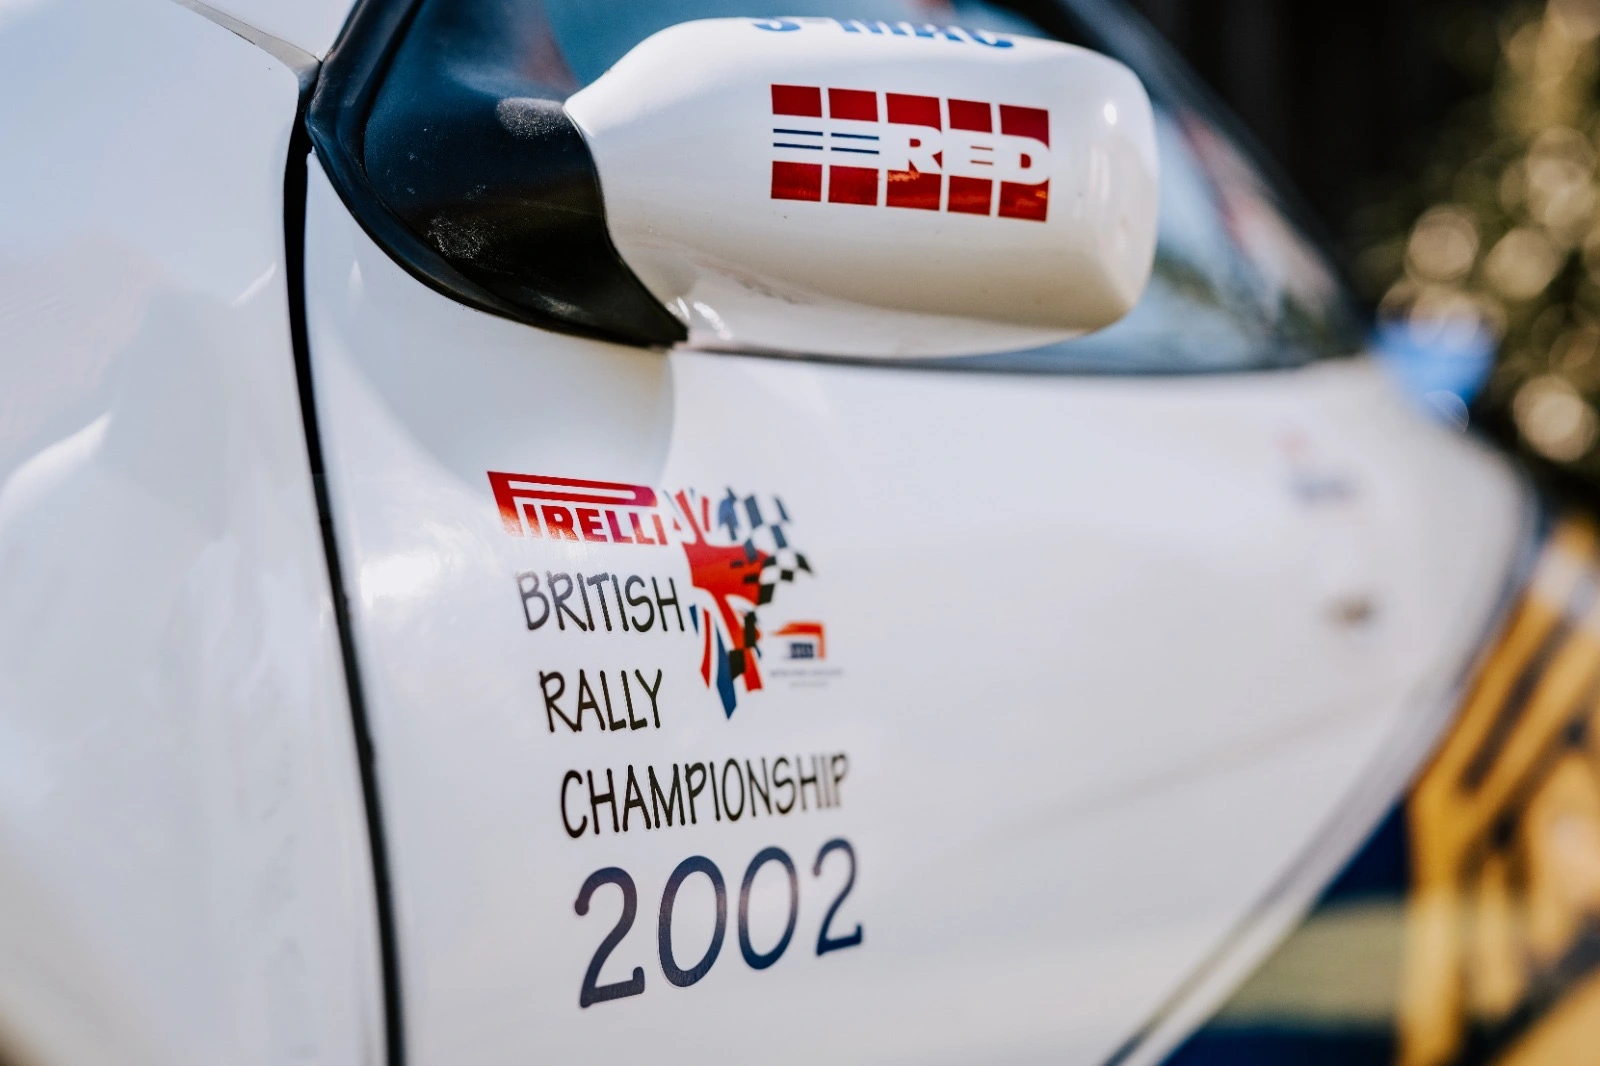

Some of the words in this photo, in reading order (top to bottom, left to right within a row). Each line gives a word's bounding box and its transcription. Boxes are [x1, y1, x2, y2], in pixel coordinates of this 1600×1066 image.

[887, 121, 1050, 186] RED
[487, 471, 668, 546] PIRELLI
[515, 570, 685, 633] BRITISH
[538, 668, 662, 733] RALLY
[561, 750, 849, 839] CHAMPIONSHIP
[573, 837, 864, 1009] 2002
